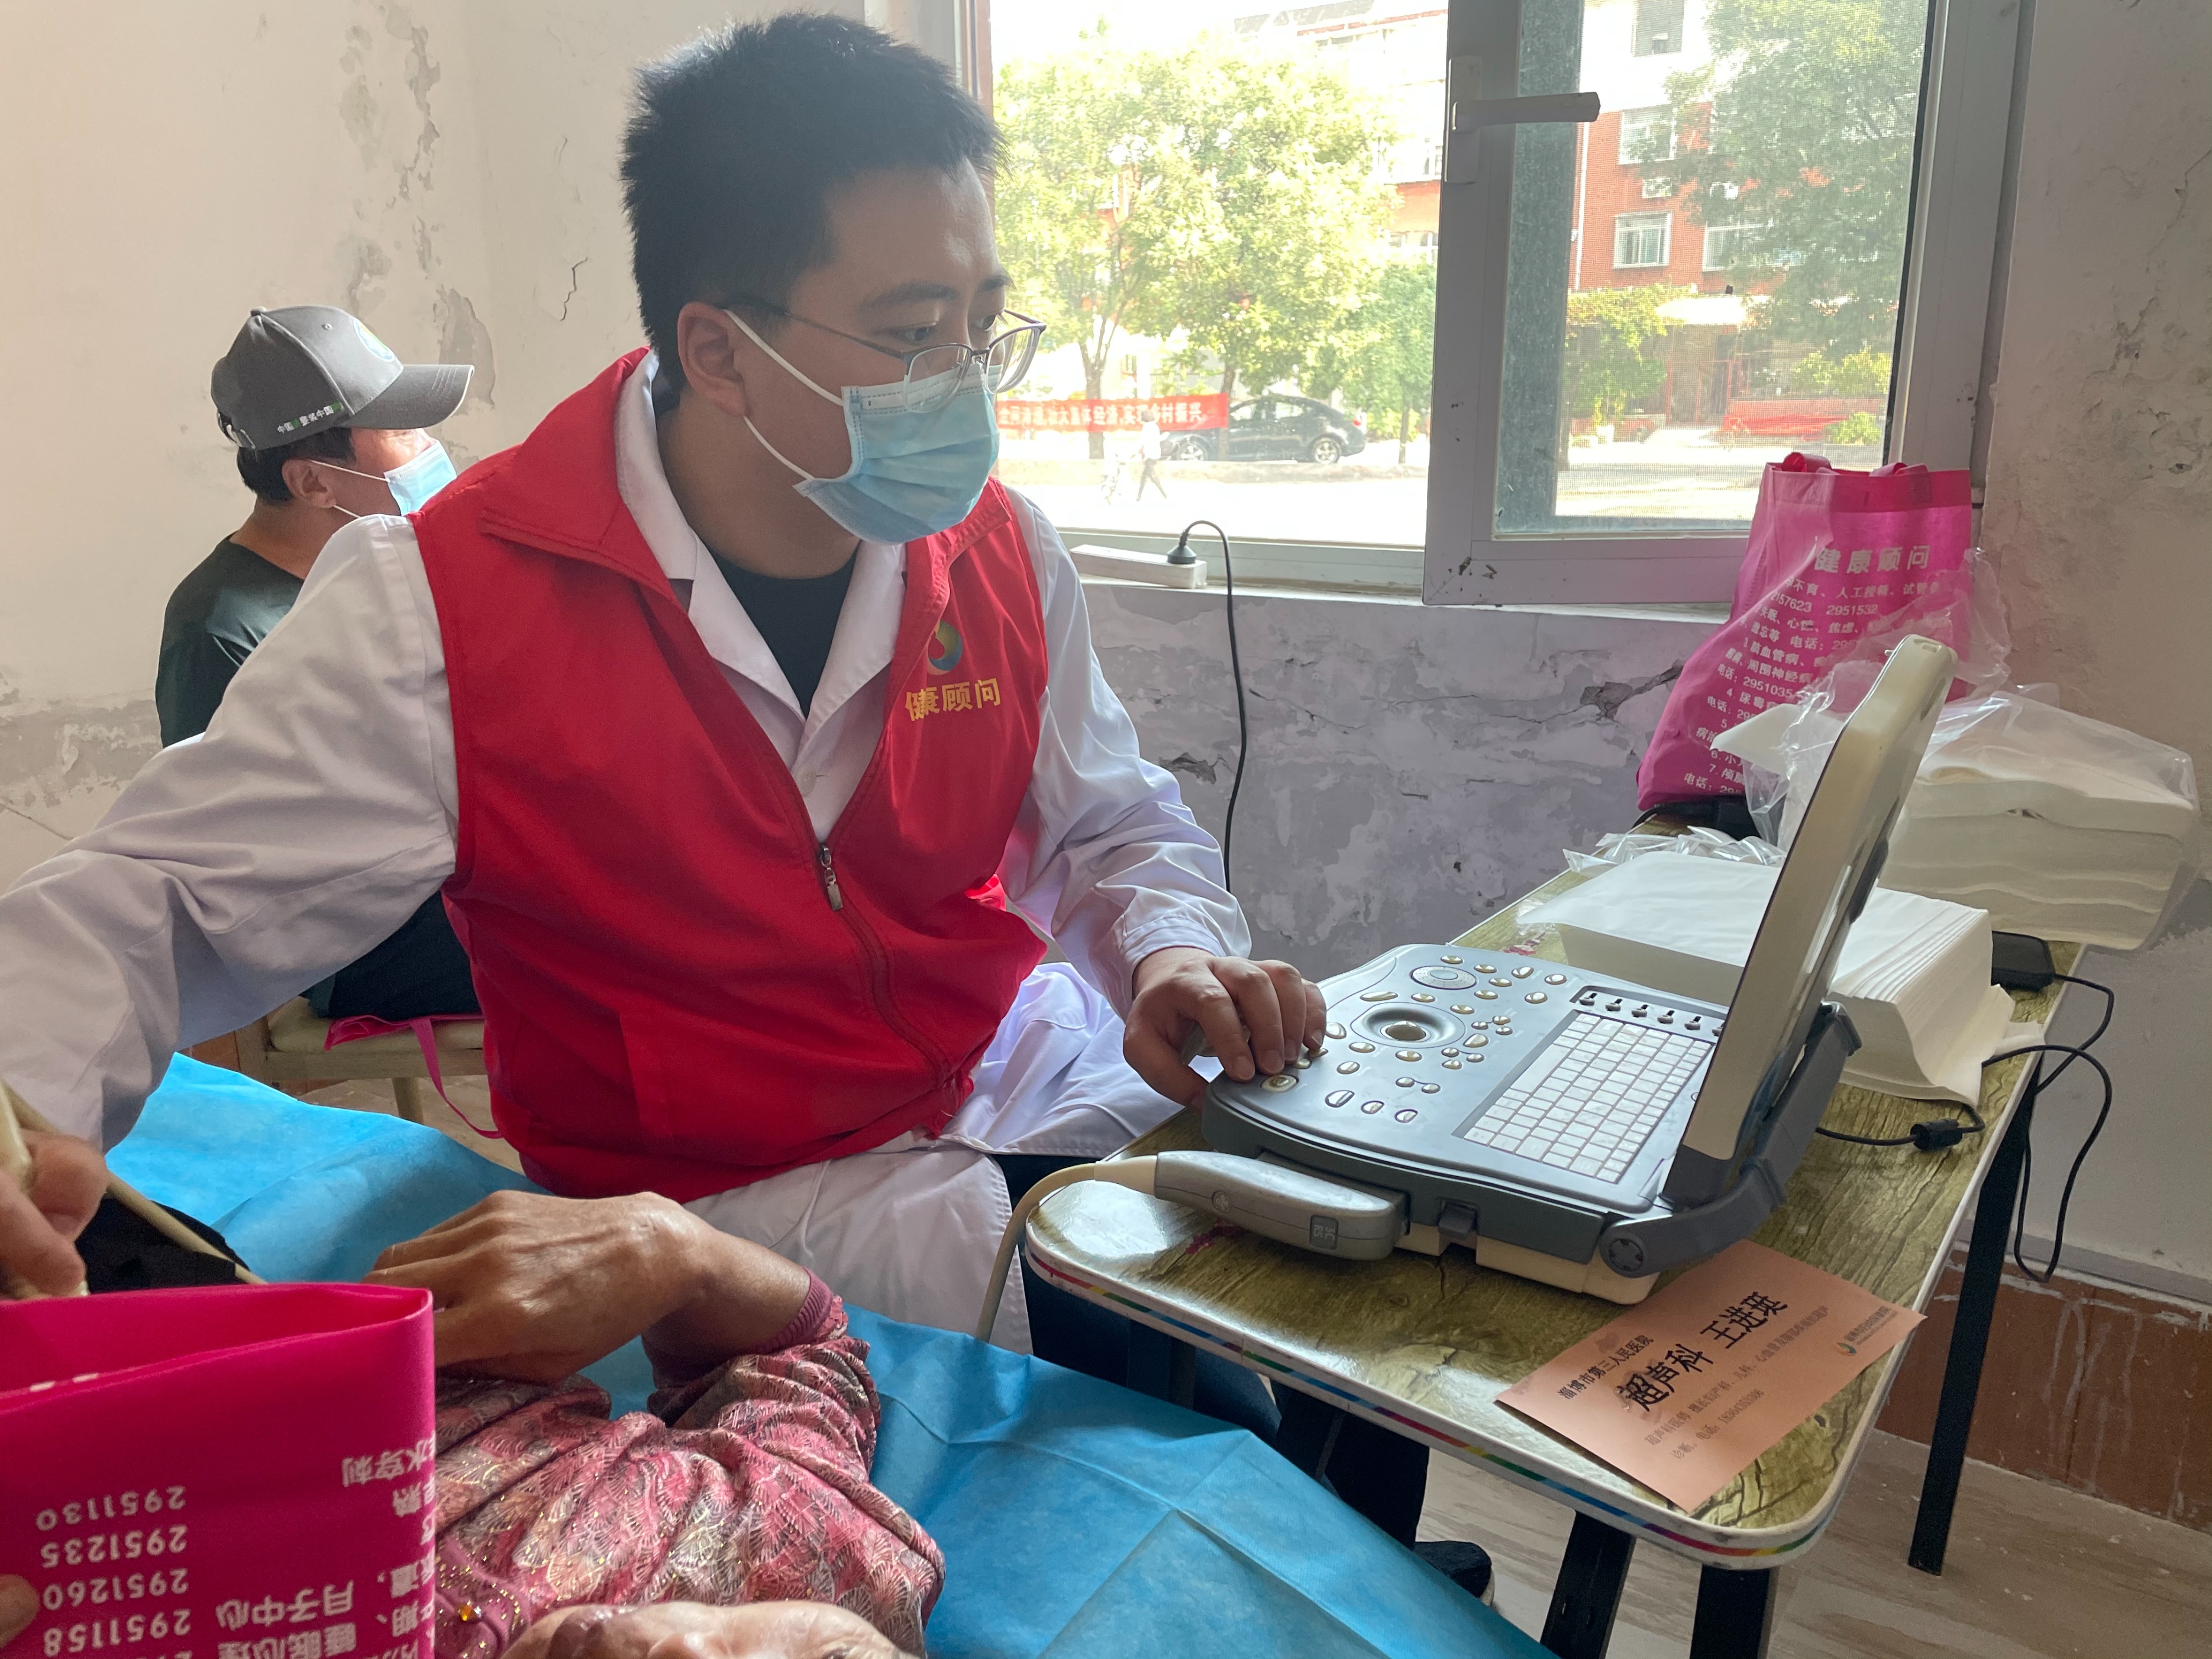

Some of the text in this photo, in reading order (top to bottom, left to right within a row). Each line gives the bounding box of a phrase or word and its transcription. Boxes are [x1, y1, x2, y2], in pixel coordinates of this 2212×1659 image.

[1814, 546, 1931, 574] 健康顾问
[1826, 605, 1878, 615] 2951532
[1557, 1335, 1654, 1400] 淄博市第三人民医院
[1616, 1344, 1714, 1412] 超声科
[36, 1486, 186, 1531] 2951130
[40, 1524, 188, 1568] 2951235
[43, 1568, 189, 1611] 2951260
[216, 1581, 354, 1631] 月子中心
[43, 1608, 192, 1657] 2951158
